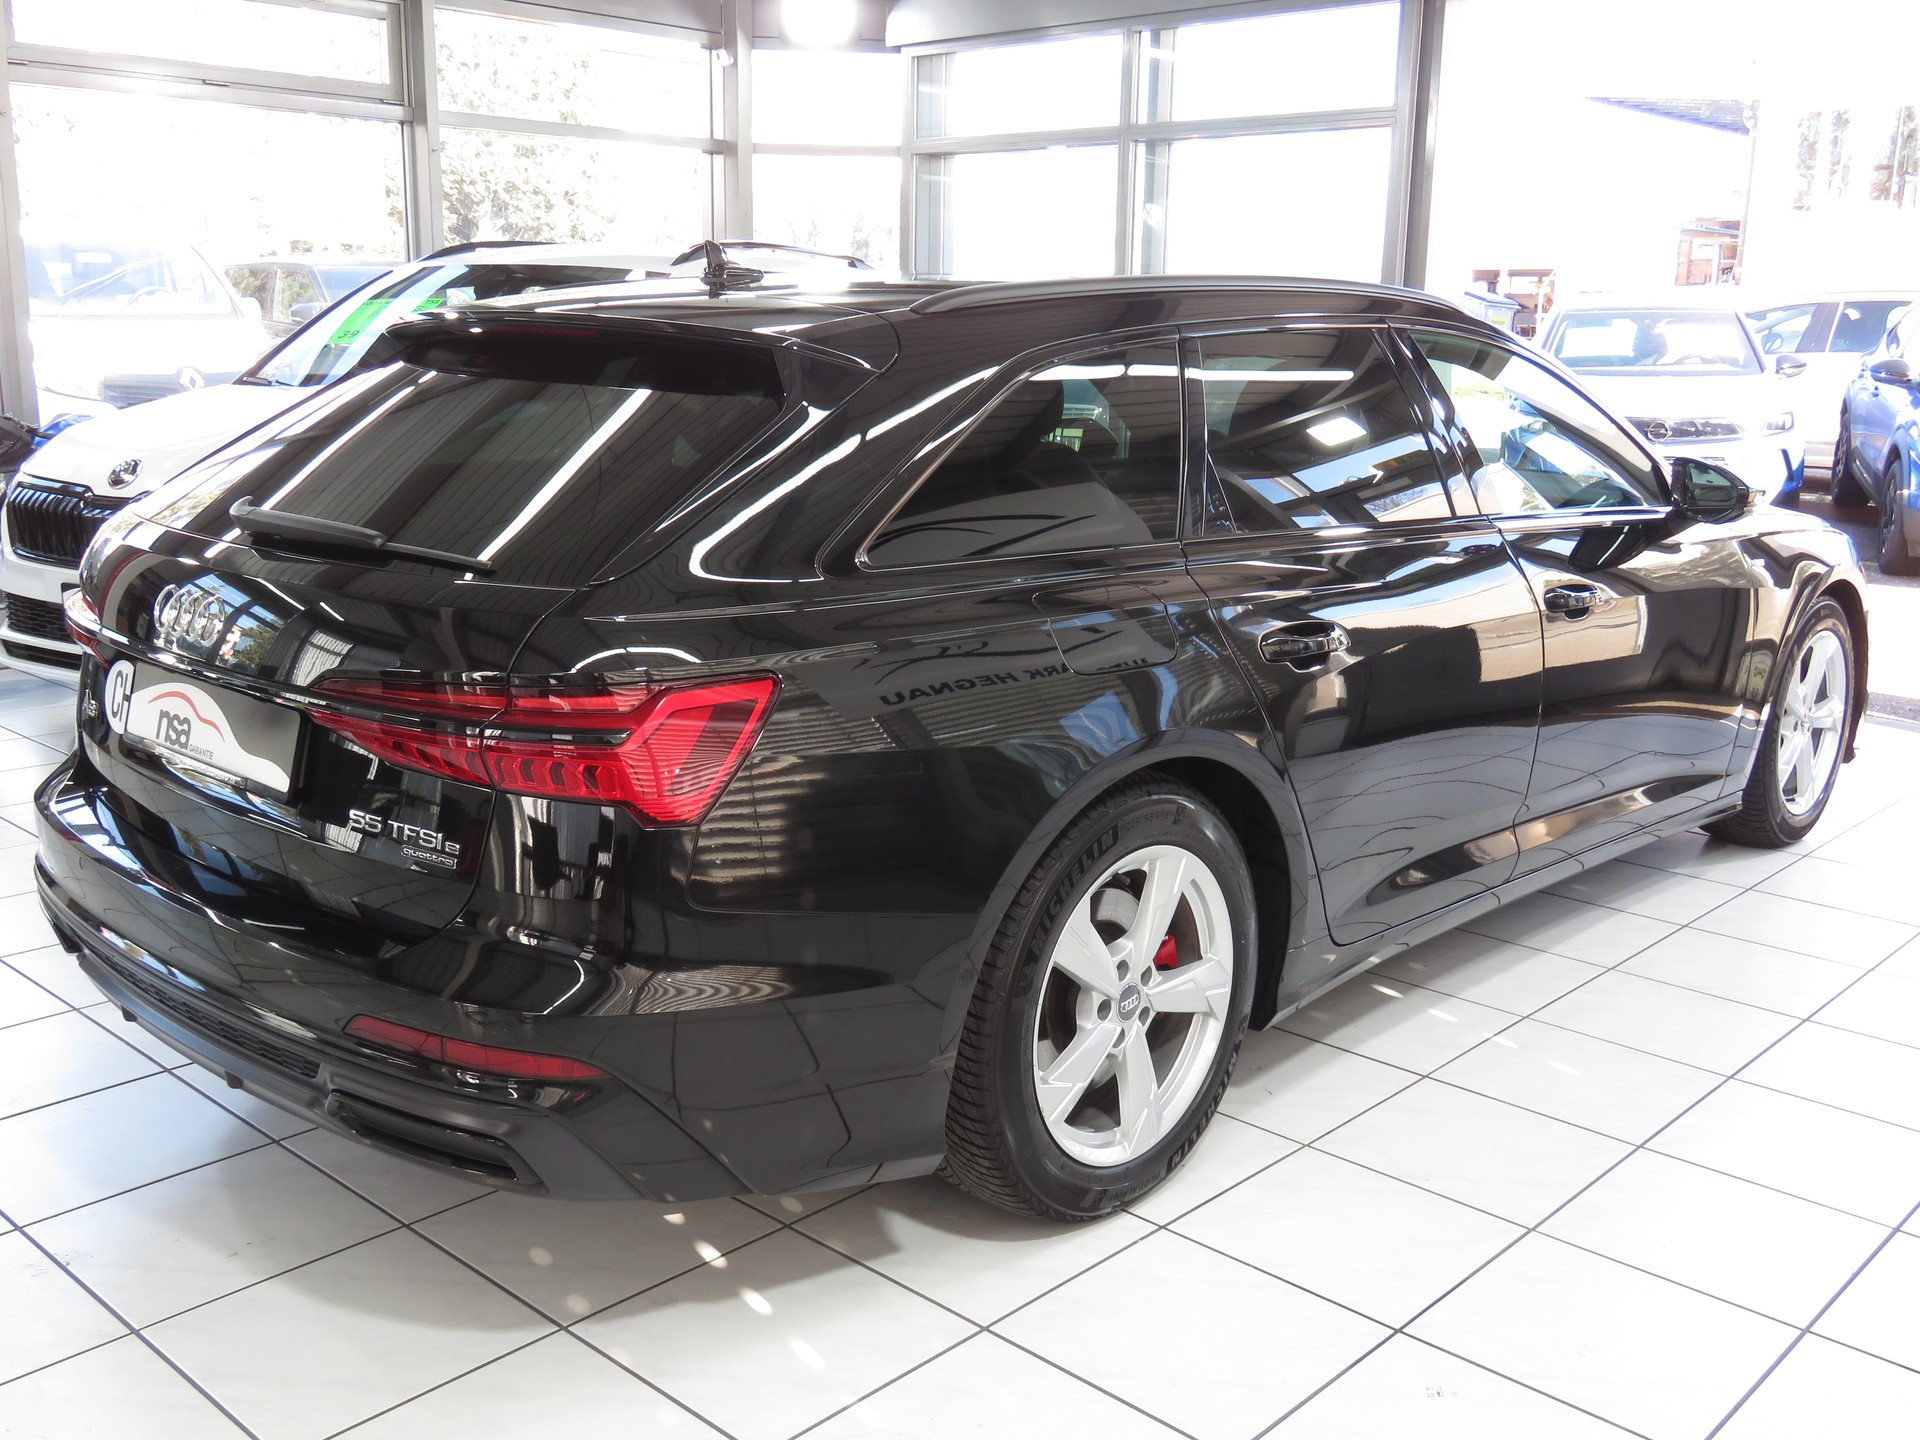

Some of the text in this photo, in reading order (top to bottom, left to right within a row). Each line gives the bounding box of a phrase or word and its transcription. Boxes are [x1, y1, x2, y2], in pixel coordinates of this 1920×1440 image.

[156, 709, 191, 750] nsa
[189, 743, 214, 760] GARANTIE
[349, 809, 382, 833] 55
[387, 820, 443, 850] TFSI
[402, 846, 456, 867] quattro
[1030, 828, 1115, 955] MICHELIN
[1170, 1050, 1238, 1168] MICHELIN
